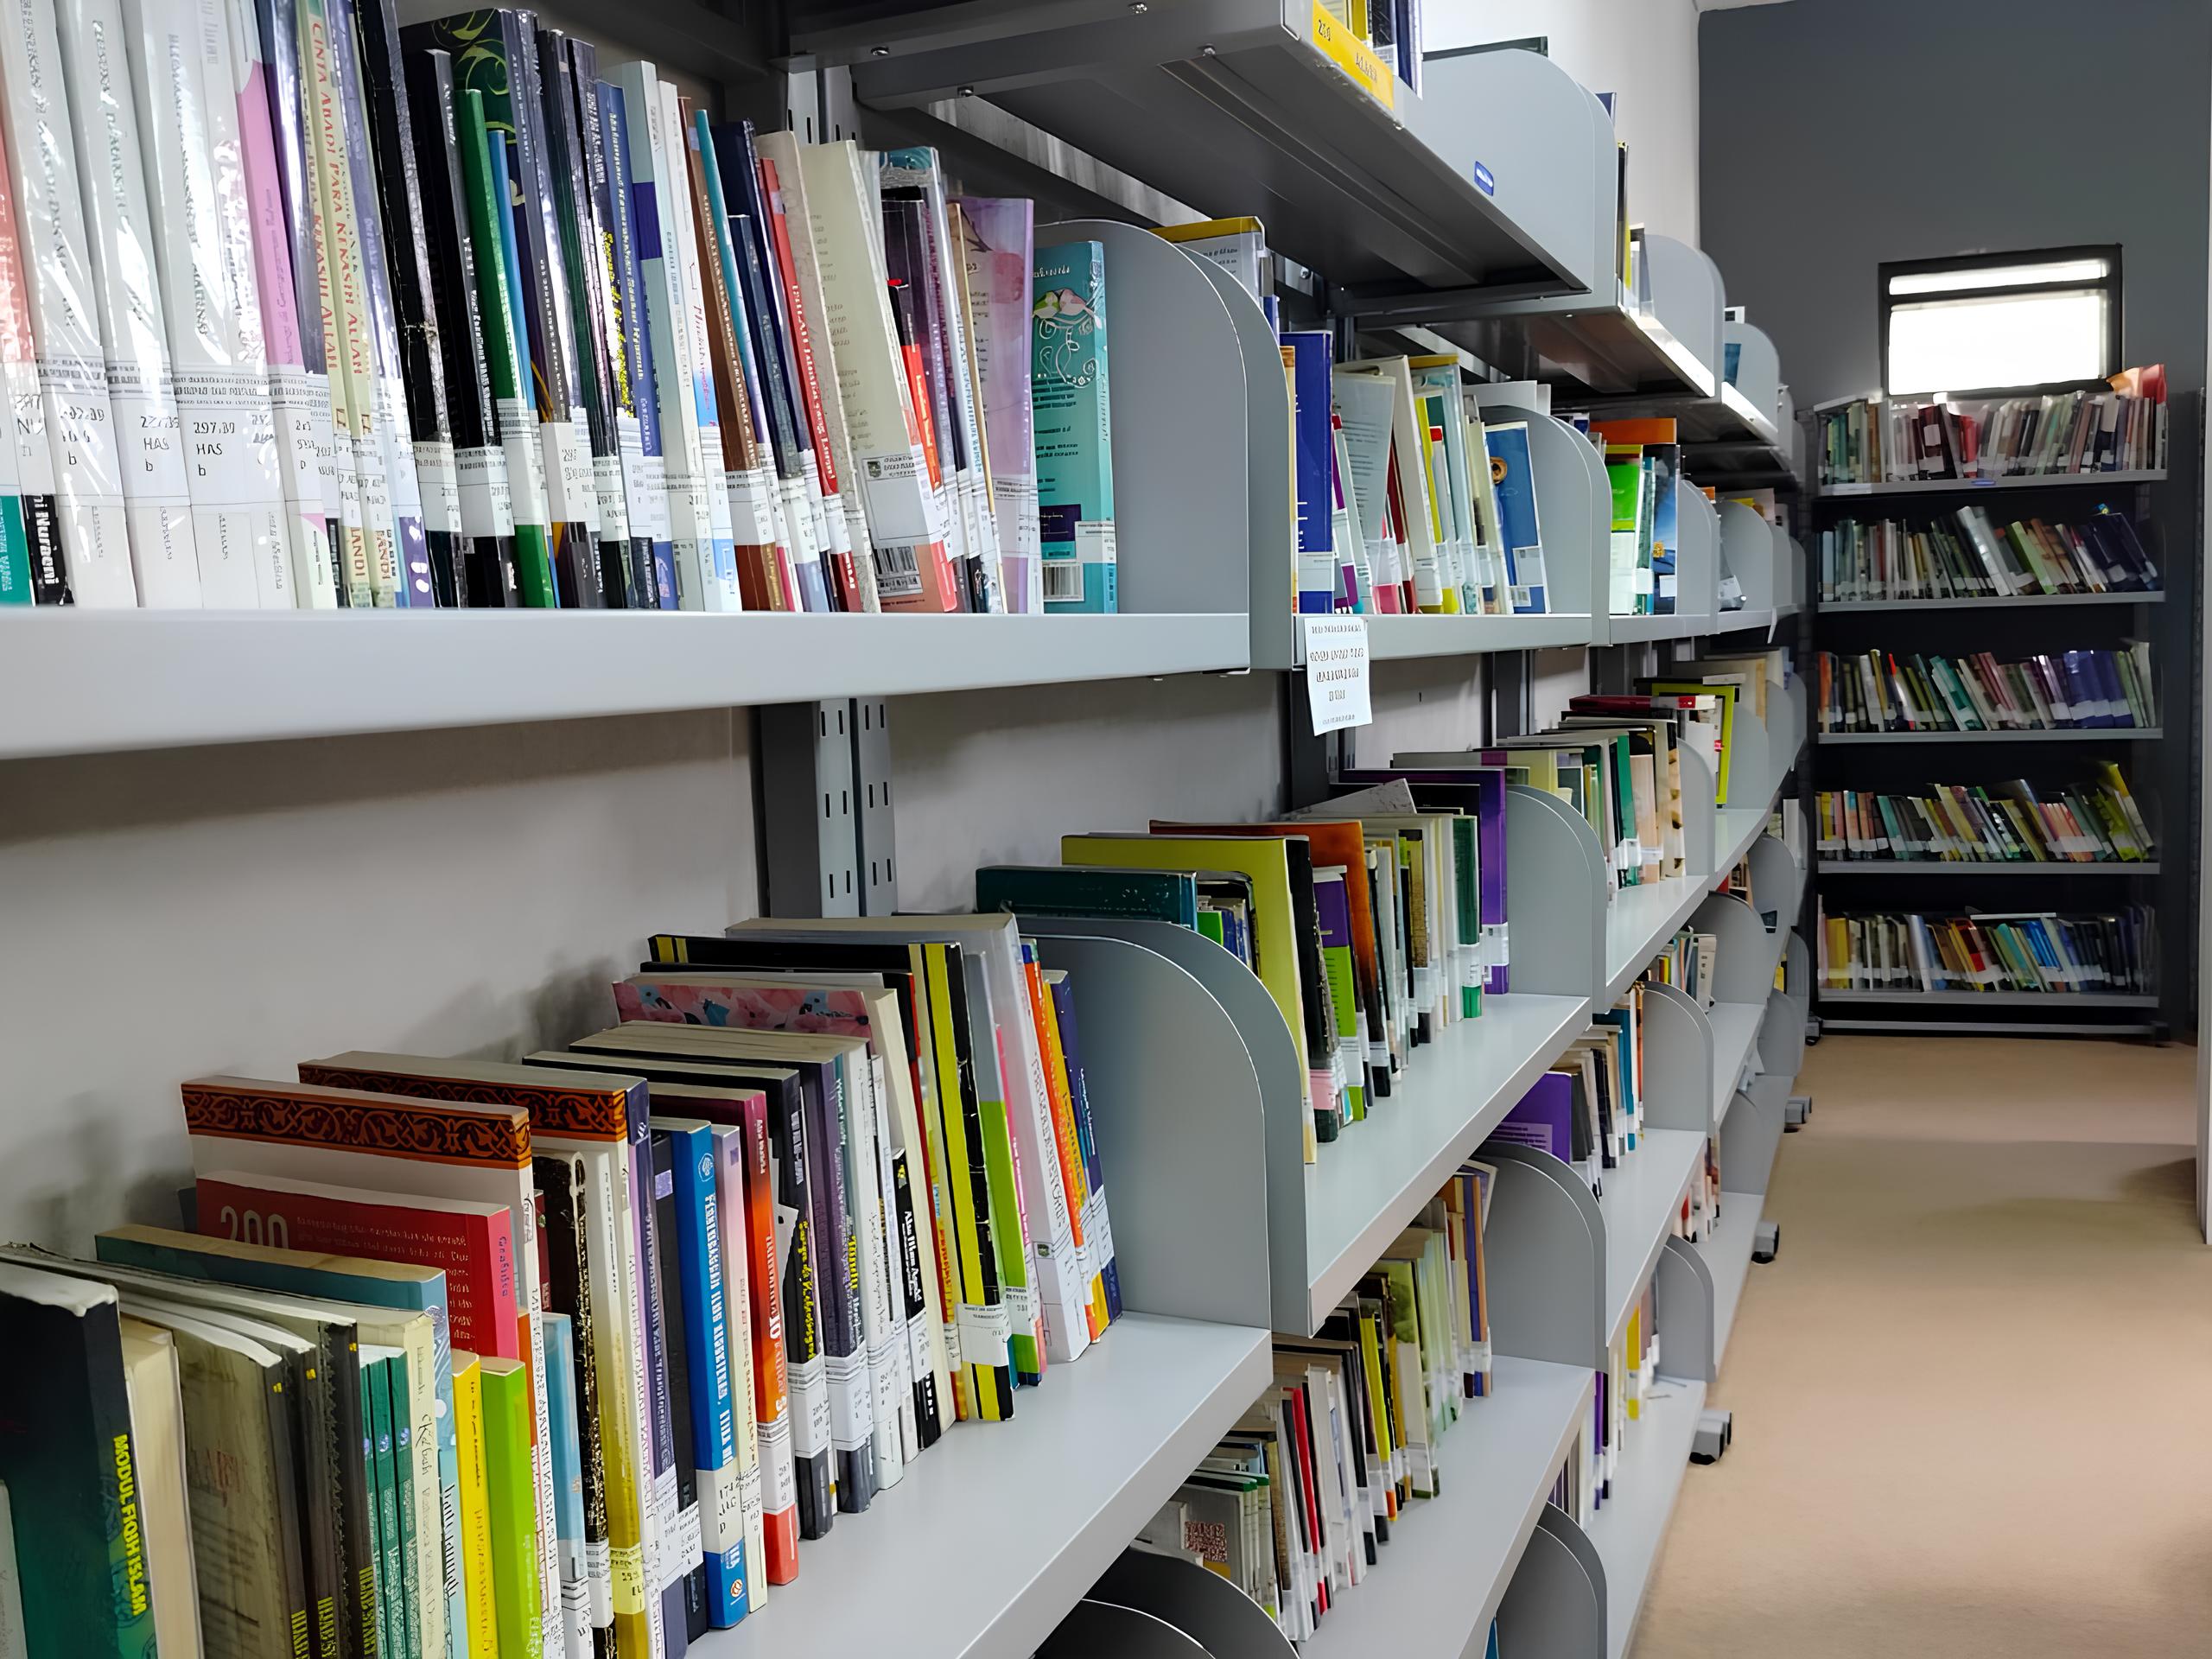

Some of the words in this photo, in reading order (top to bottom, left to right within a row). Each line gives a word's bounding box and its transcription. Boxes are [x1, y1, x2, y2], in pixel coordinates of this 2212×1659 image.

[310, 22, 327, 83] CINTA
[320, 91, 337, 154] ABADI
[329, 161, 343, 213] PARA
[336, 221, 355, 305] KEKASIH
[346, 311, 363, 375] ALLAH
[321, 305, 338, 370] ALLAH
[220, 1205, 289, 1250] 200
[113, 1434, 136, 1503] MODUL
[125, 1554, 149, 1616] ISLAM
